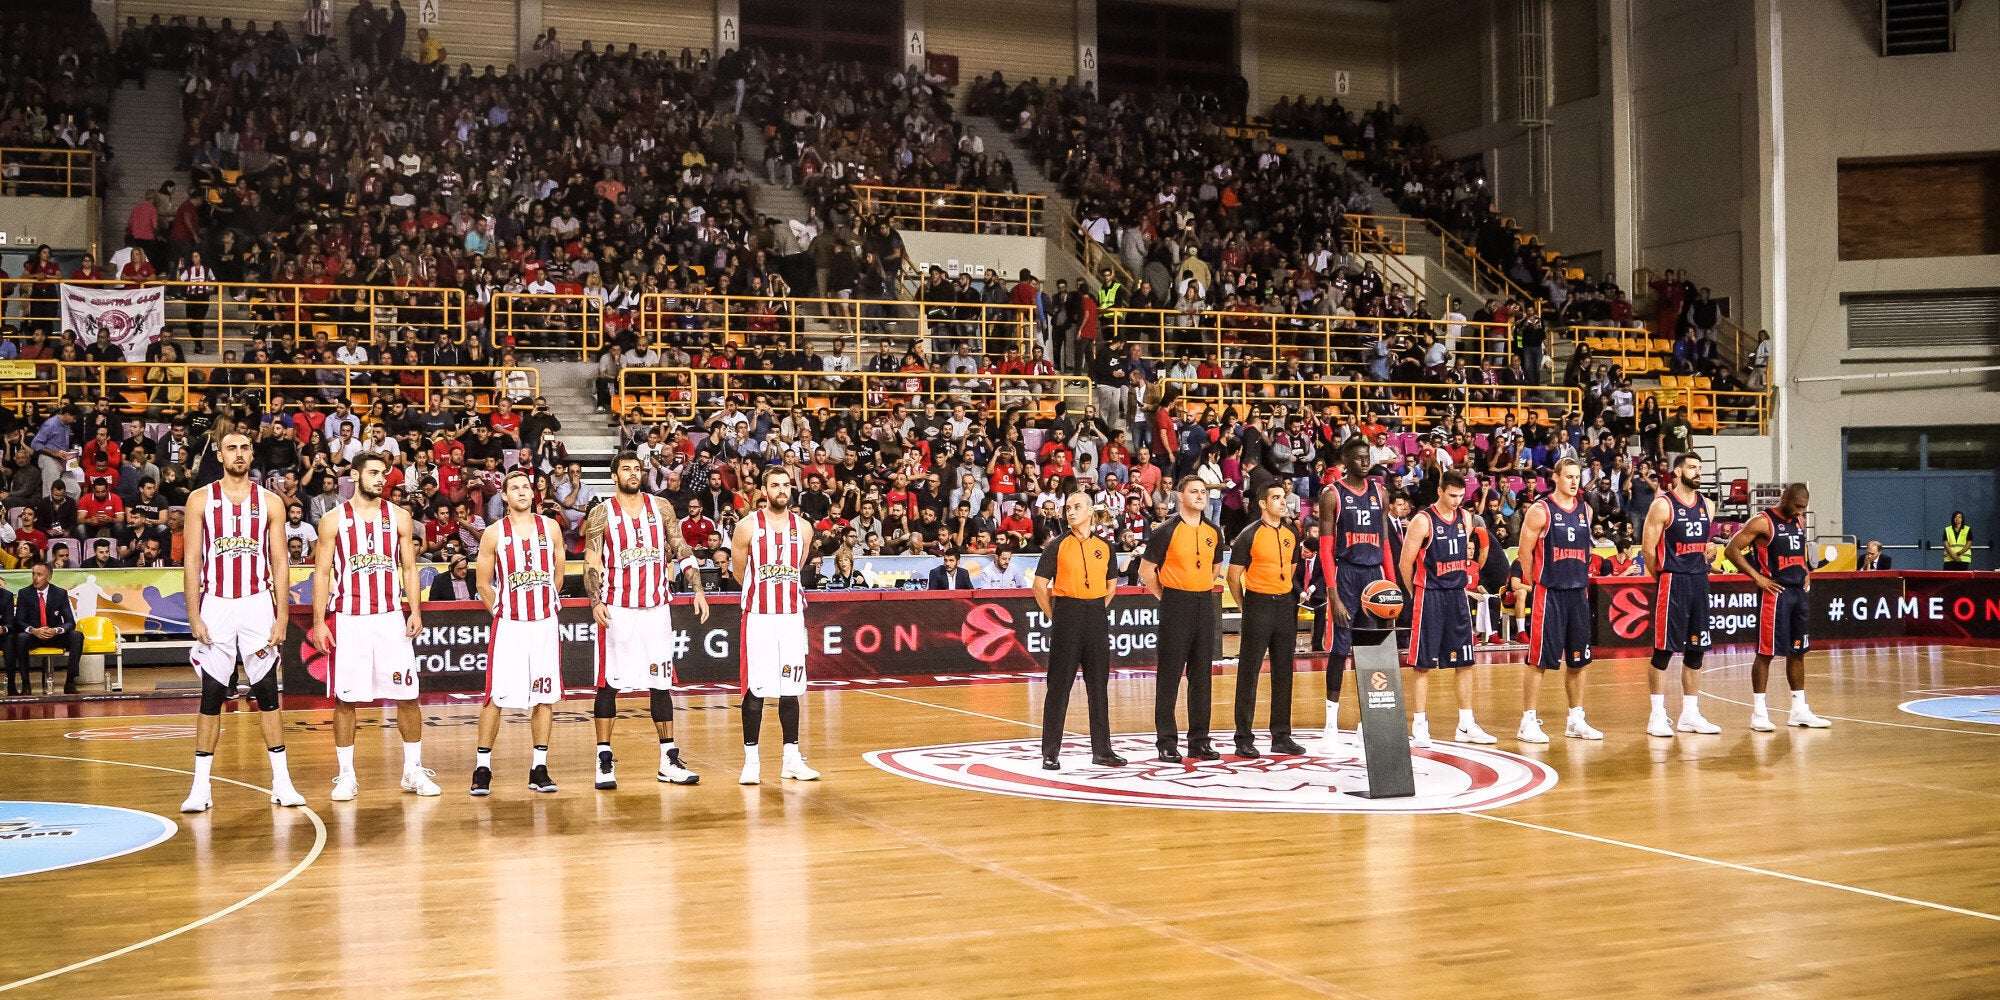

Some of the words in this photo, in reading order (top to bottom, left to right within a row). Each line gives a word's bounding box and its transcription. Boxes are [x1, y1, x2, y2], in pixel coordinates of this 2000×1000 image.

[424, 0, 434, 11] A
[422, 12, 437, 23] 12
[724, 18, 734, 29] A
[723, 29, 735, 40] 11
[911, 32, 920, 42] A
[911, 43, 922, 54] 11
[1084, 47, 1093, 58] A
[1083, 59, 1095, 69] 10
[1339, 72, 1346, 82] A
[1339, 82, 1346, 93] 9
[231, 515, 243, 533] 11
[1357, 510, 1371, 525] 12
[1567, 526, 1576, 542] 6
[1685, 522, 1703, 537] 23
[367, 533, 375, 550] 6
[1449, 538, 1459, 555] 11
[1788, 535, 1801, 550] 15
[522, 549, 535, 567] 13
[774, 545, 785, 561] 17
[1462, 644, 1473, 661] 11
[1584, 643, 1591, 660] 6
[661, 660, 672, 678] 15
[793, 665, 804, 683] 17
[405, 669, 413, 686] 6
[538, 677, 552, 694] 13
